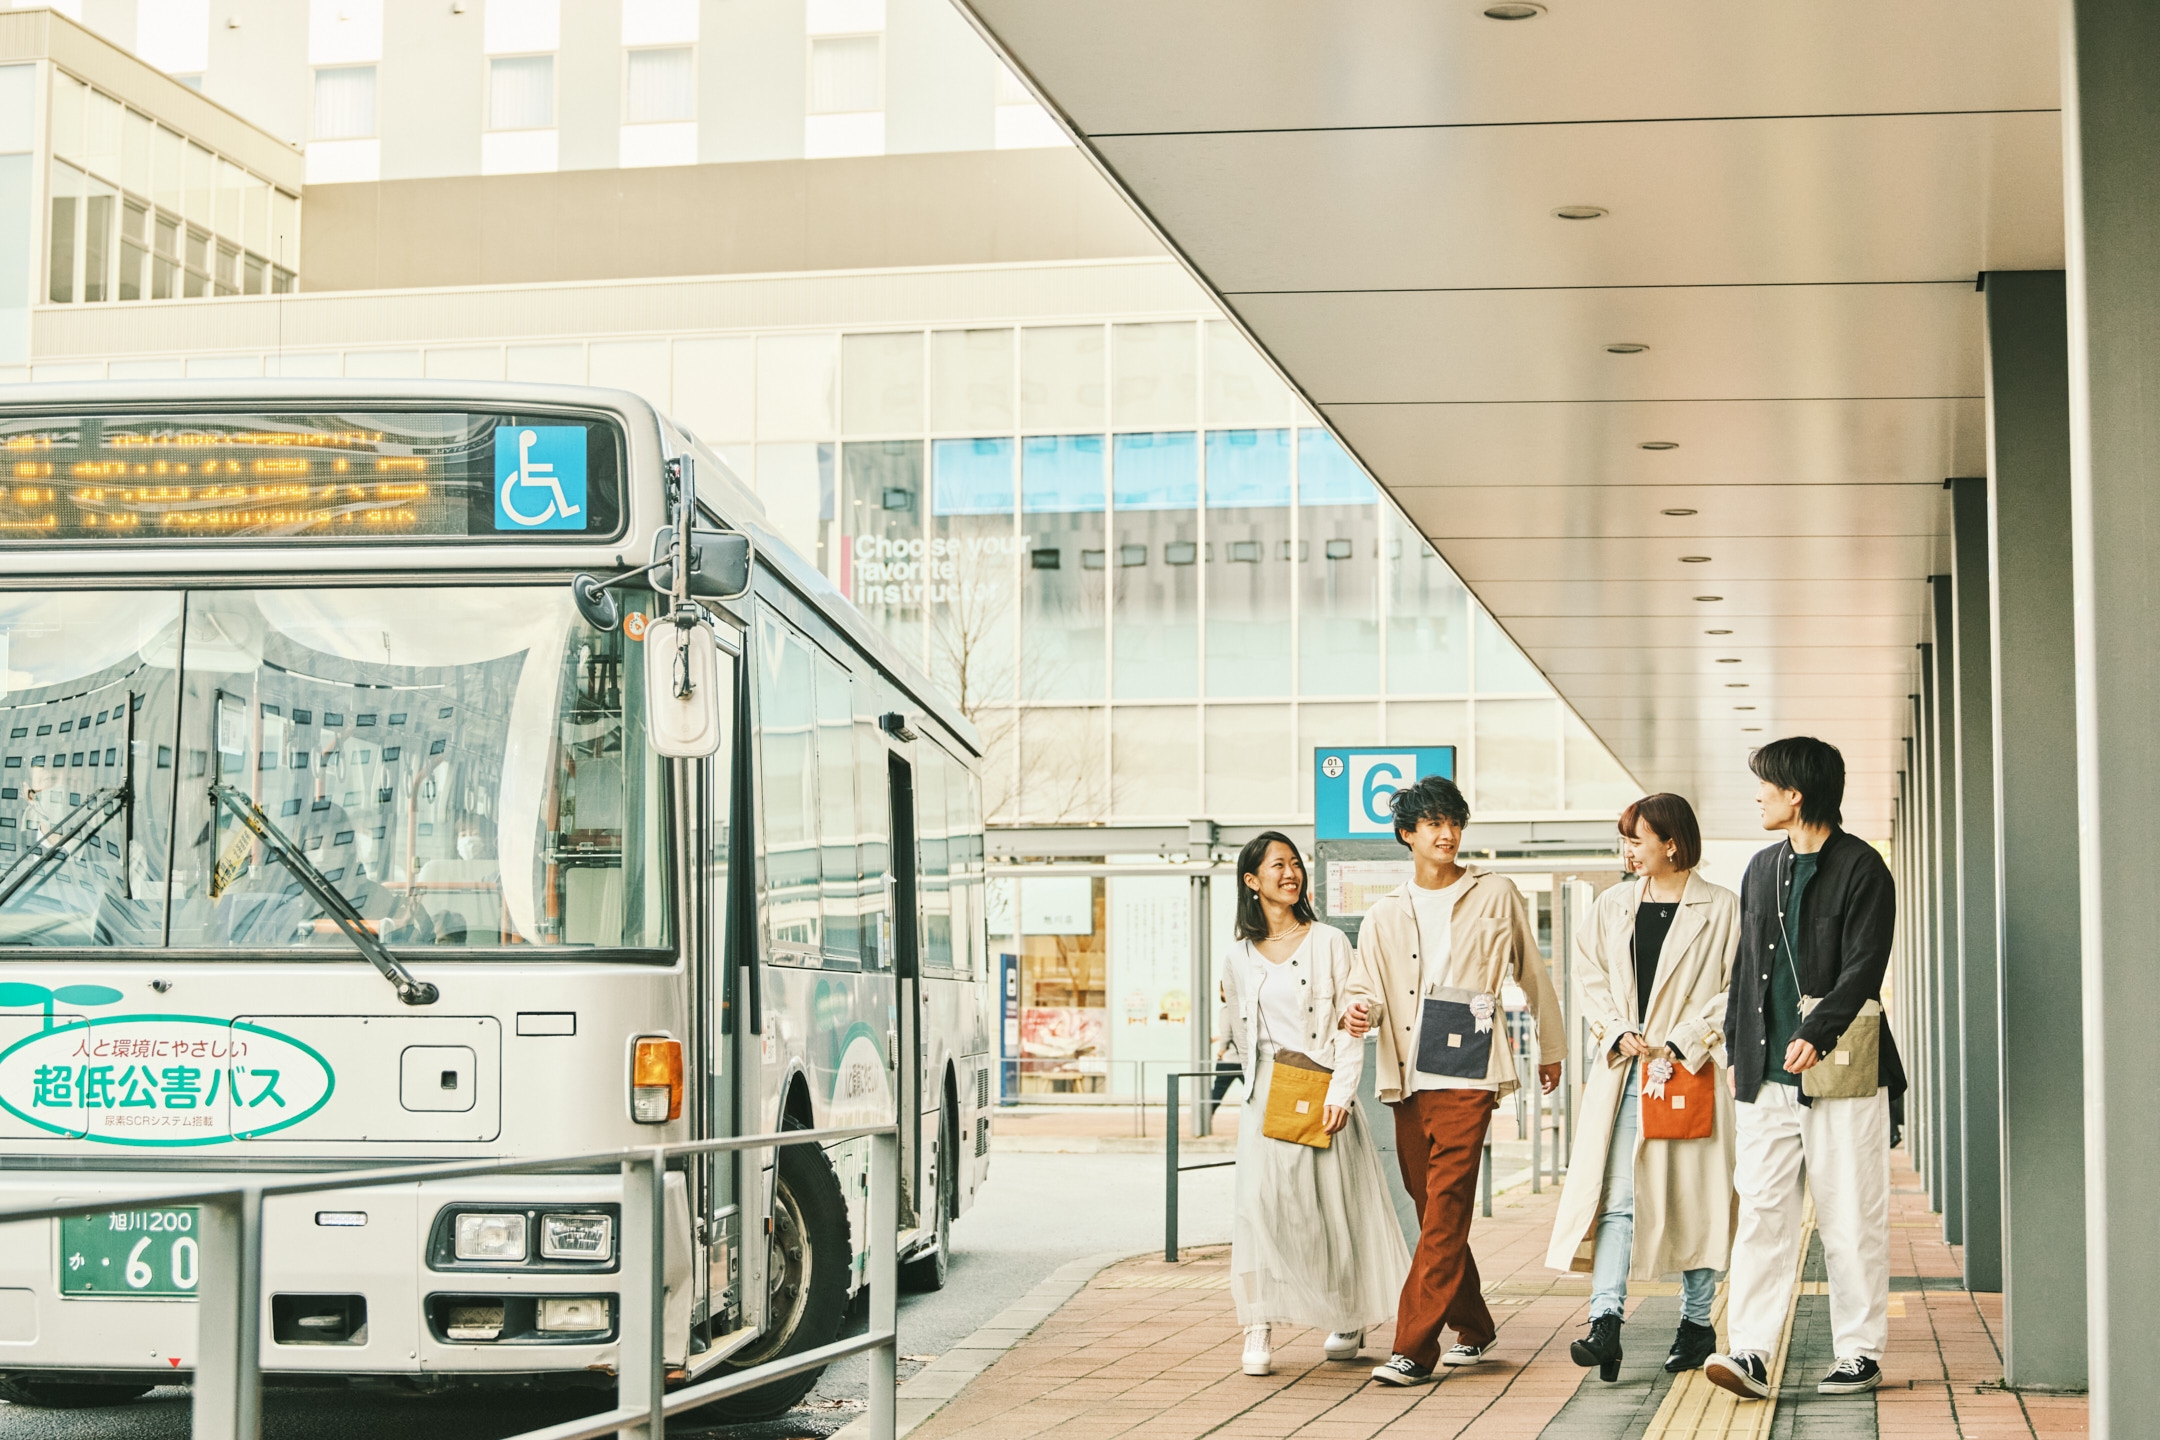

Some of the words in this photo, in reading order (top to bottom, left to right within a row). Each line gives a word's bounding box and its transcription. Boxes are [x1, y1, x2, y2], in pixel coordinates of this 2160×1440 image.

[855, 534, 960, 557] Choose
[968, 536, 1031, 557] your
[857, 559, 955, 581] favorite
[858, 583, 997, 604] instructor
[1327, 758, 1338, 766] 01
[1362, 763, 1402, 824] 6
[72, 1038, 248, 1058] 人と環境にやさしい
[32, 1064, 286, 1109] 超低公害バス
[104, 1115, 214, 1127] 尿素SCRシステム搭載
[109, 1212, 191, 1231] 旭川200
[69, 1252, 85, 1270] か
